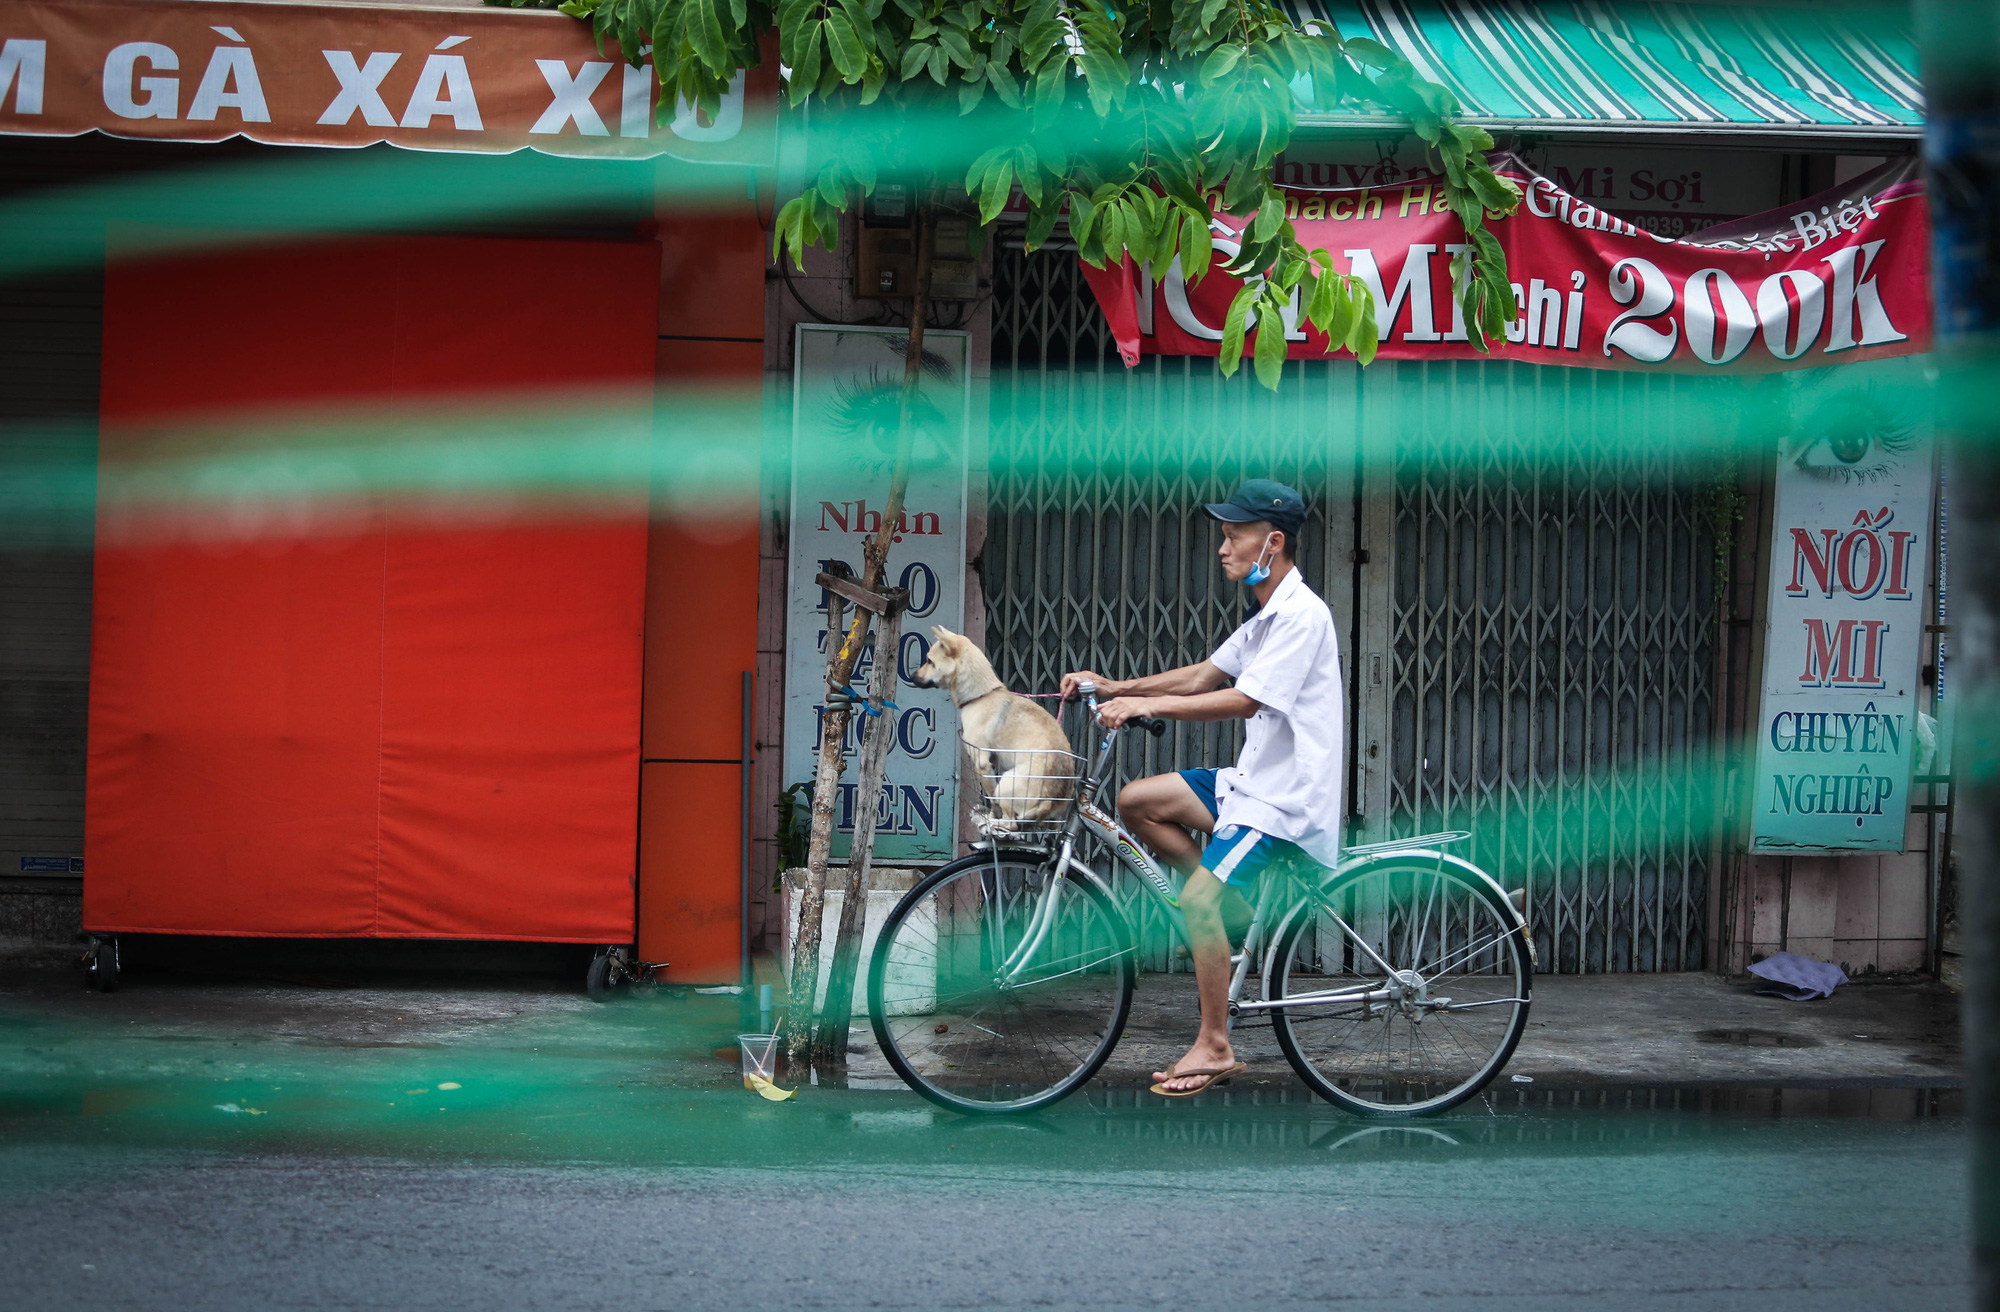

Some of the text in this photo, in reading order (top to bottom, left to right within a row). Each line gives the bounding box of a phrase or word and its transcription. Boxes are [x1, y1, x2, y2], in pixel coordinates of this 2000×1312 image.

[103, 26, 271, 122] GÀ
[316, 35, 484, 131] XÁ
[1553, 166, 1616, 199] Mi
[1629, 169, 1705, 209] Sợi
[1791, 193, 1880, 253] Biệt
[1504, 270, 1588, 349] chỉ
[1603, 238, 1908, 365] 200K
[1785, 506, 1916, 599] NỐI
[1799, 619, 1889, 688] MI
[1771, 702, 1903, 754] CHUYÊN
[1770, 763, 1893, 828] NGHIỆP
[1132, 857, 1171, 894] martin
